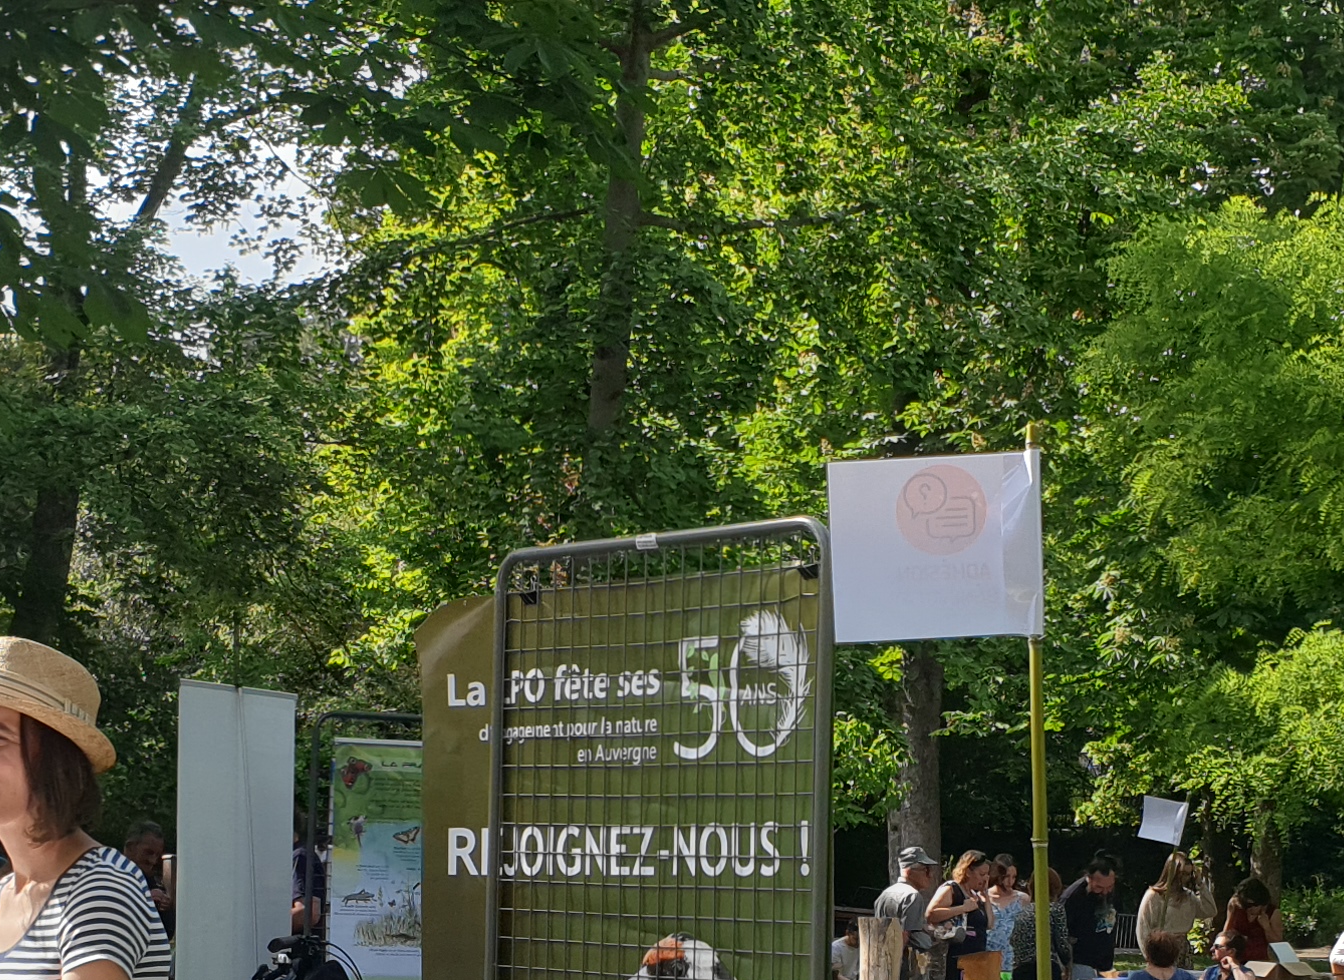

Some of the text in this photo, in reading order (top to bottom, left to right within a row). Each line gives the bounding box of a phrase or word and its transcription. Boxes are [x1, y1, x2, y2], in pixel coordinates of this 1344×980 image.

[447, 664, 660, 707] La PO fête ses
[673, 609, 812, 760] 50
[742, 682, 777, 707] ANS
[567, 722, 597, 741] pour
[601, 716, 611, 734] la
[616, 717, 657, 734] nature
[577, 744, 657, 766] en Auvergne
